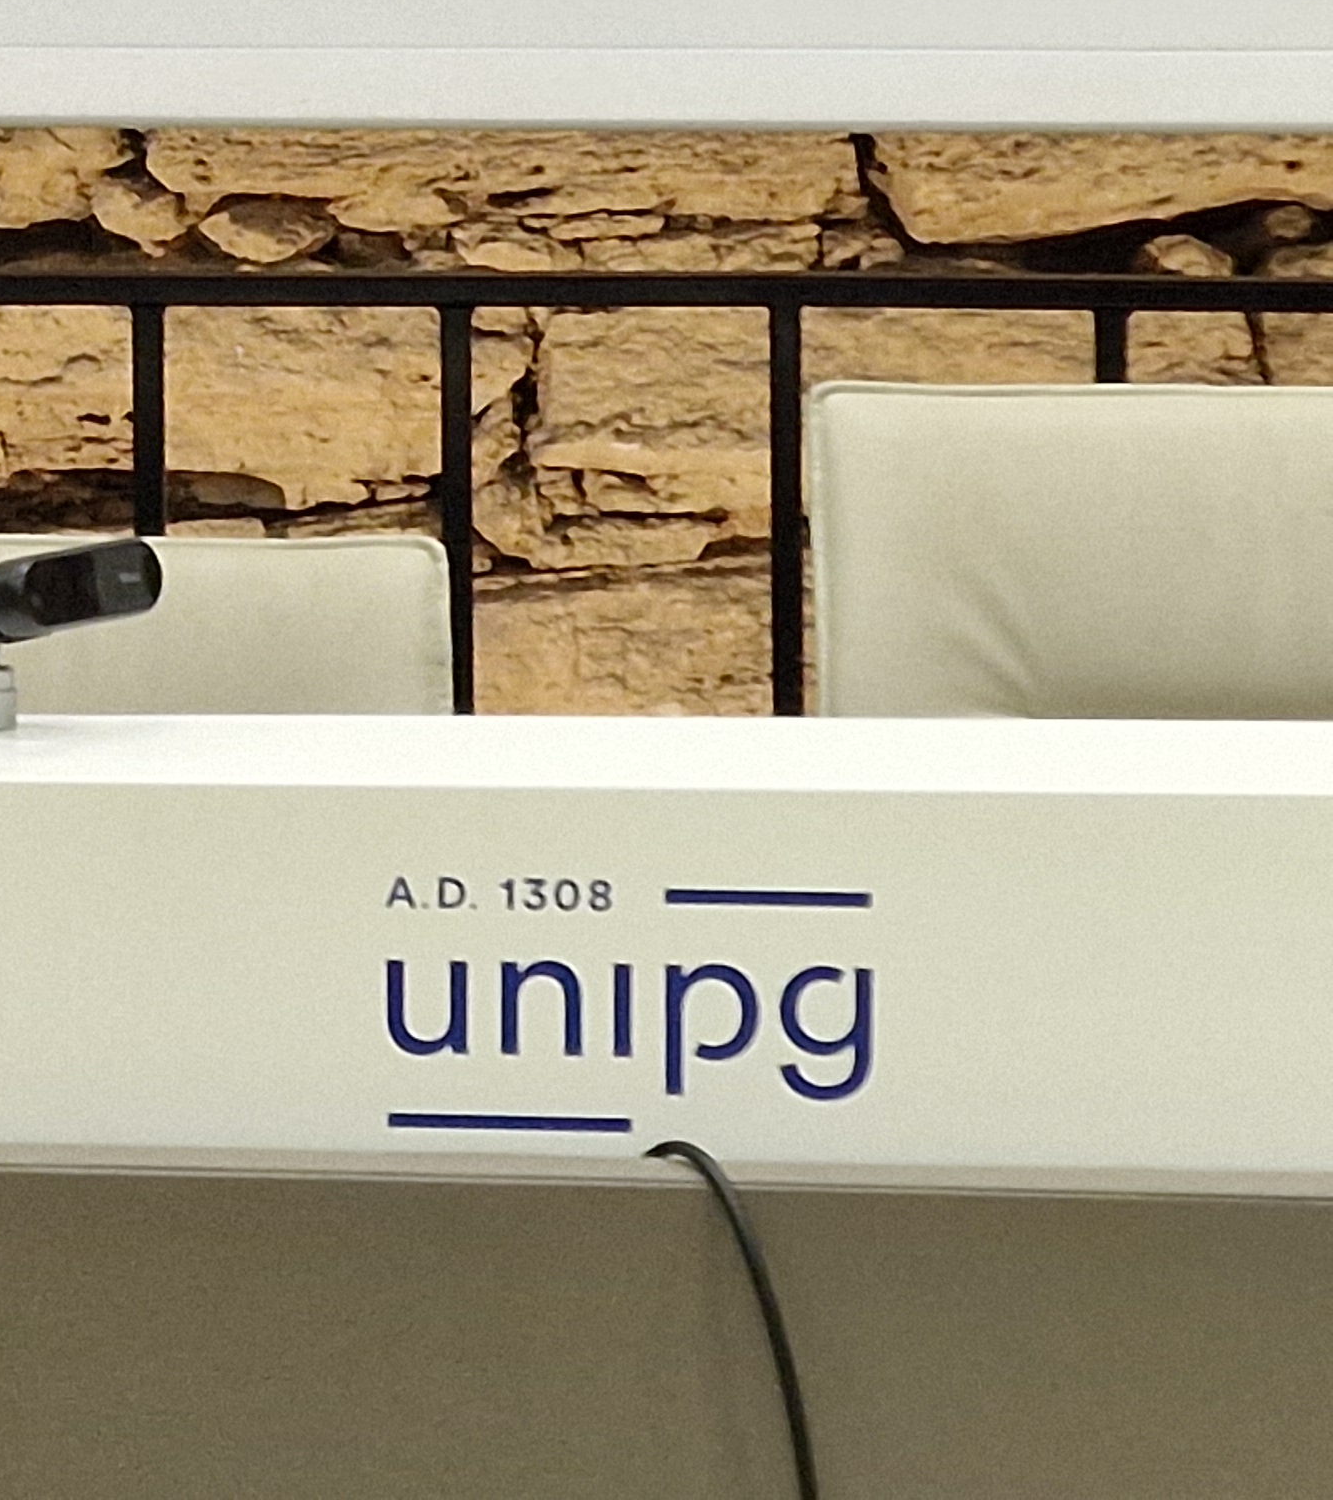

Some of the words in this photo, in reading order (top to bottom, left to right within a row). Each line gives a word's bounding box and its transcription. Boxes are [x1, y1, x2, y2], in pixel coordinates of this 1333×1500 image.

[386, 876, 477, 911] A.D.
[499, 878, 613, 912] 1308
[386, 959, 873, 1101] unipg
